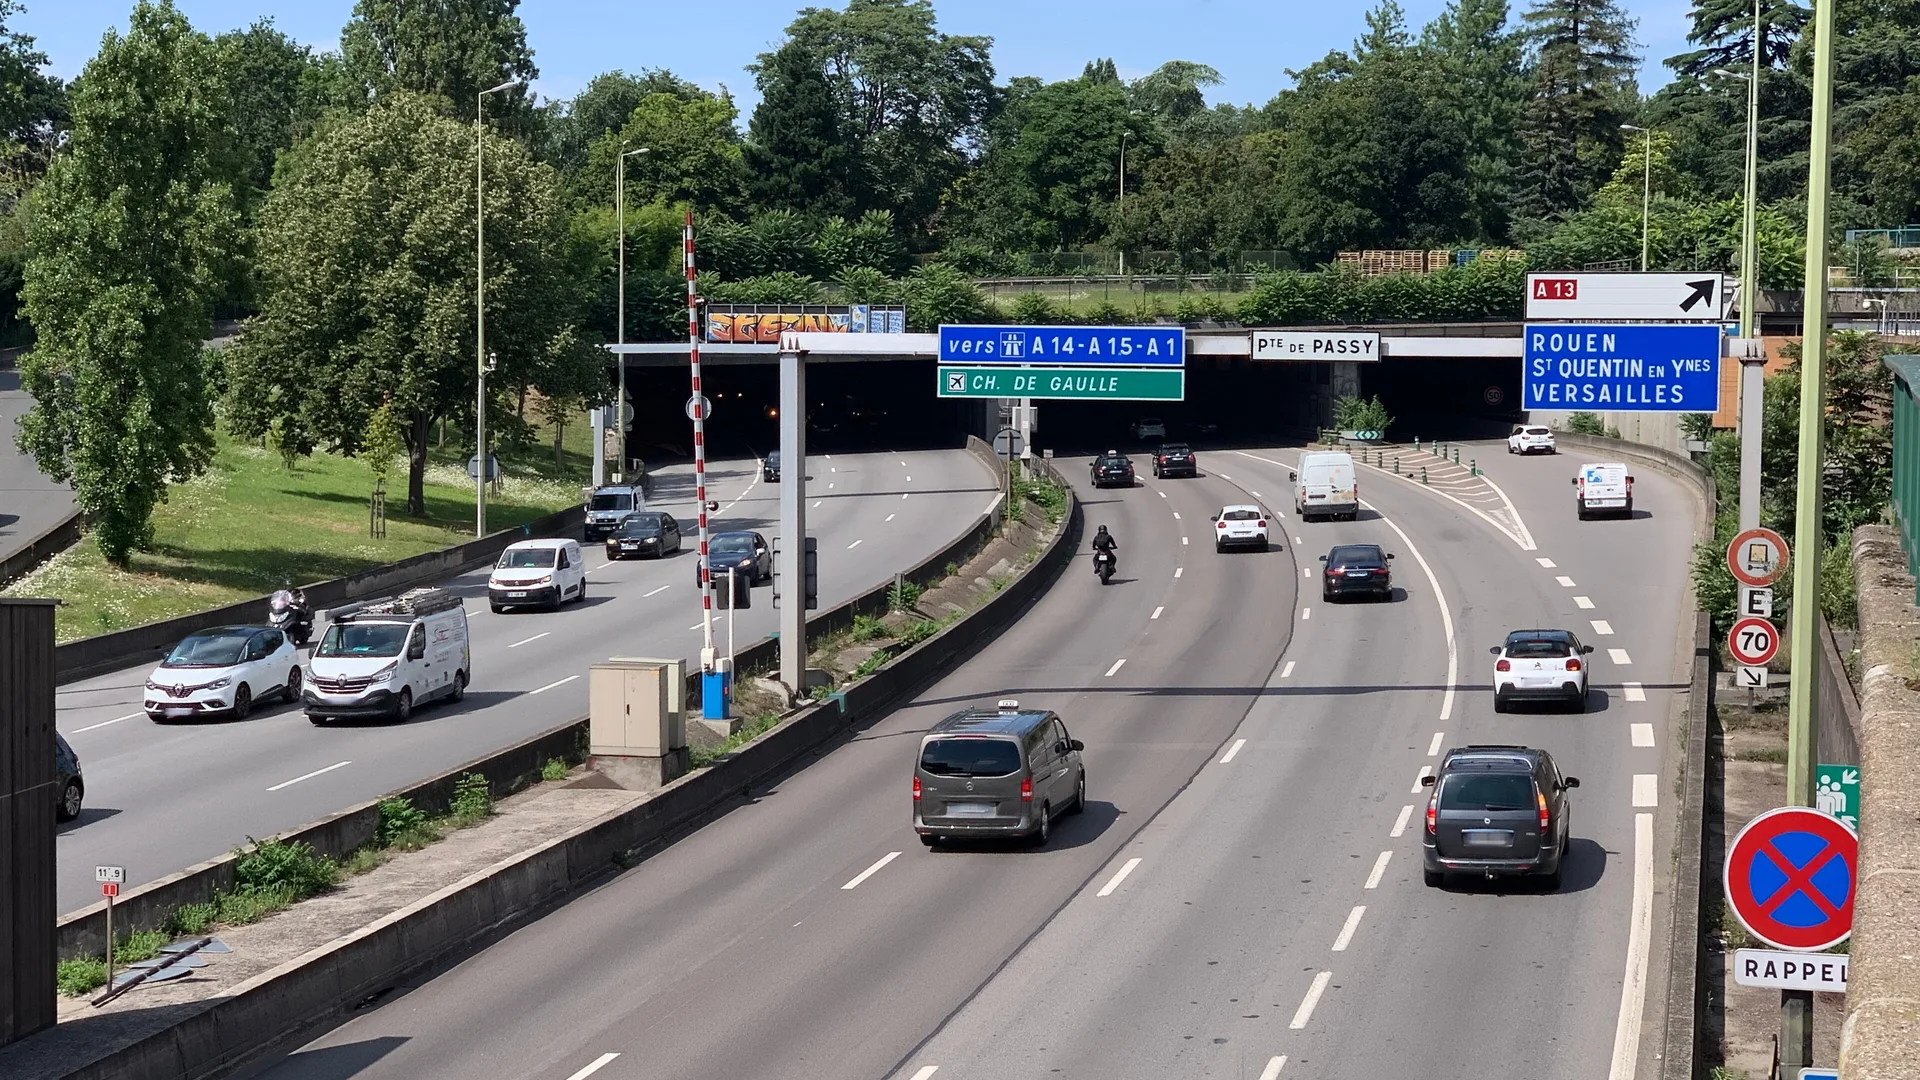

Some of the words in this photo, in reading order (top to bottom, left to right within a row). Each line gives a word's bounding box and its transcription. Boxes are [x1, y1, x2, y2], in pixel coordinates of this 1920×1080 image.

[1536, 282, 1547, 297] A
[1555, 282, 1574, 297] 13
[950, 341, 994, 353] vers
[1290, 344, 1304, 352] DE
[1314, 340, 1372, 353] PASSY
[1534, 334, 1615, 352] ROUEN
[1560, 359, 1642, 378] QUENTIN
[1649, 366, 1664, 377] EN
[973, 376, 999, 389] CH.
[1014, 377, 1036, 389] DE
[1051, 377, 1117, 391] GAULLE
[1533, 383, 1684, 403] VERSAILLES
[1748, 590, 1766, 615] E
[1741, 632, 1769, 651] 70
